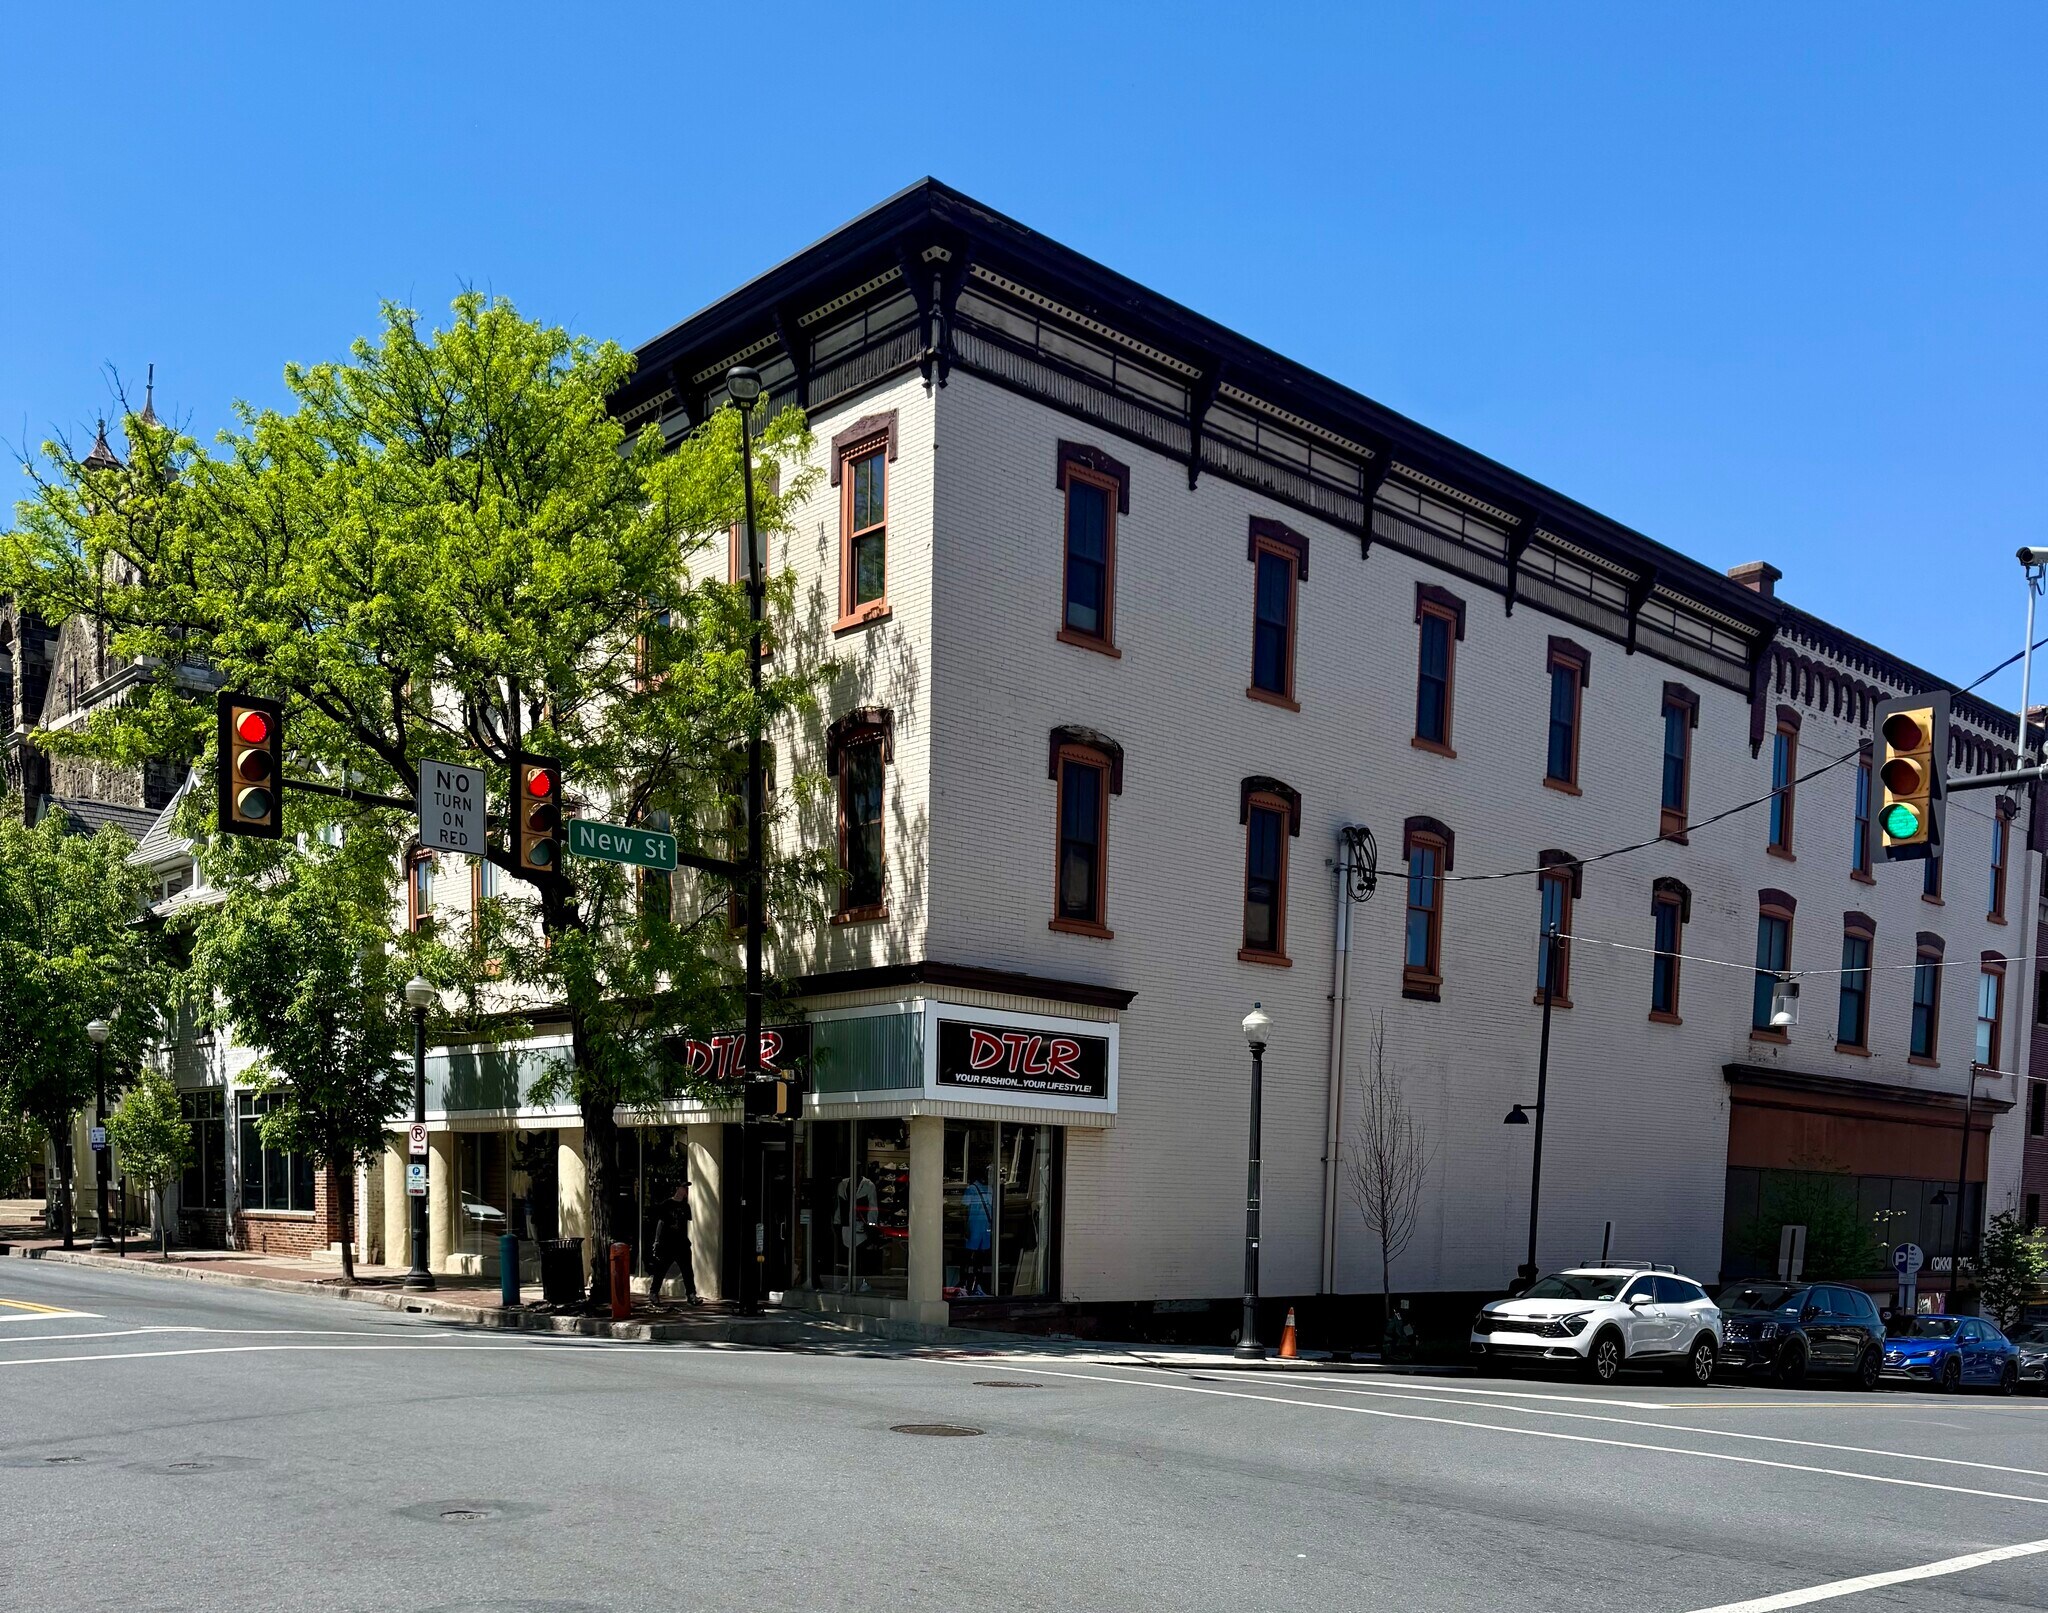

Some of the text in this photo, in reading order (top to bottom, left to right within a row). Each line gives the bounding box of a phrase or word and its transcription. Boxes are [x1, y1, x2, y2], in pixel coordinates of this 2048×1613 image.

[436, 769, 470, 793] NO
[434, 791, 472, 812] TURN
[442, 811, 464, 829] ON
[439, 828, 468, 846] RED
[580, 826, 667, 861] New St
[970, 1029, 1081, 1079] DTLR
[955, 1073, 980, 1083] YOUR
[1046, 1081, 1092, 1093] LIFESTYLE!
